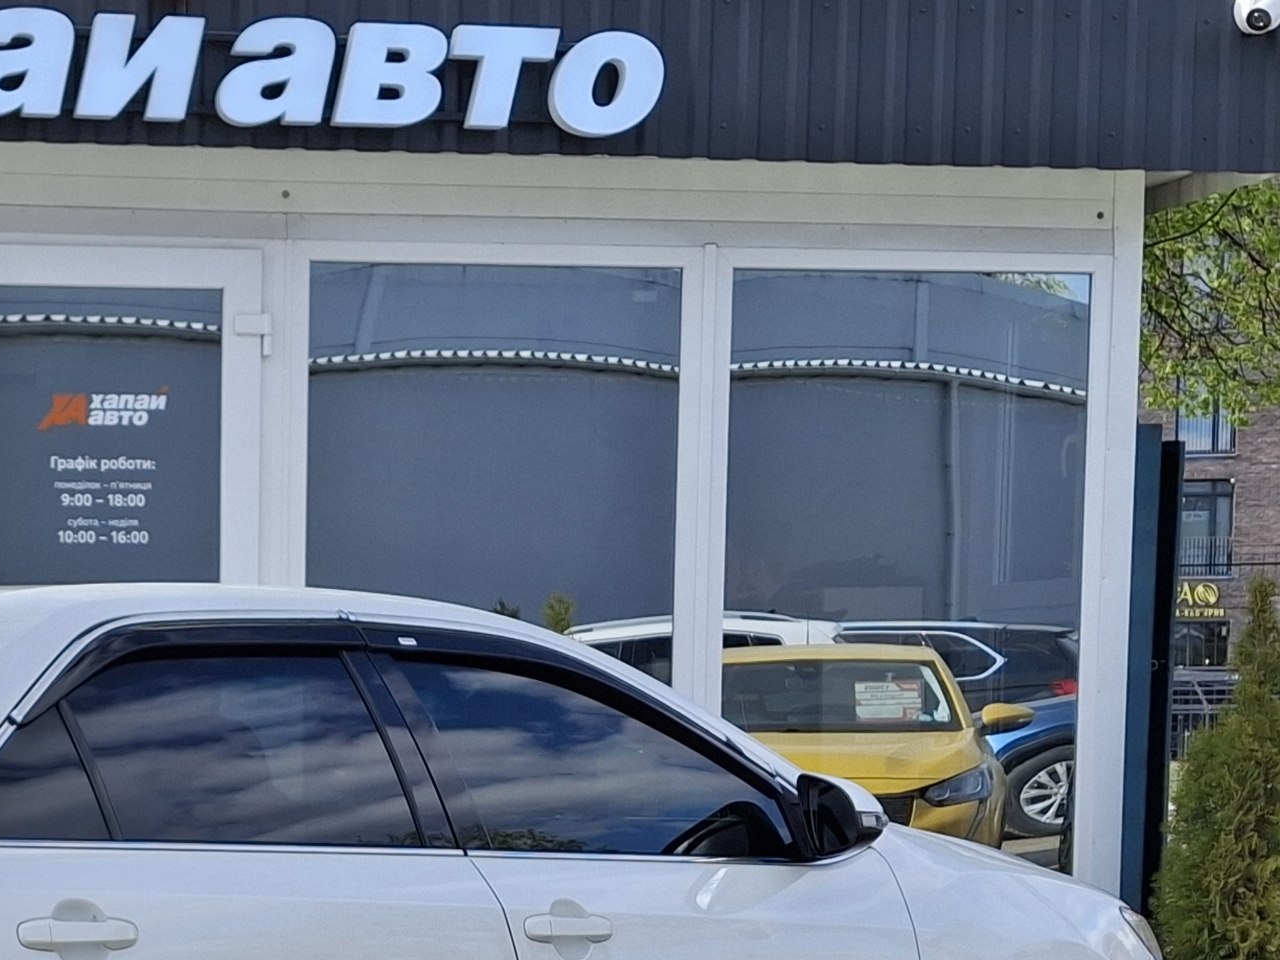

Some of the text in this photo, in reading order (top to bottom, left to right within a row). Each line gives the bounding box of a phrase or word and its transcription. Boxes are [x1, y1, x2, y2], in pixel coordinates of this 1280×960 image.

[214, 16, 666, 138] авто
[89, 385, 170, 410] хапай
[87, 409, 149, 426] авто
[50, 455, 157, 472] Графік роботи:
[60, 493, 93, 507] 9:00
[107, 493, 146, 507] 18:00
[67, 517, 100, 528] субота
[57, 530, 96, 544] 10:00
[110, 530, 149, 544] 16:00
